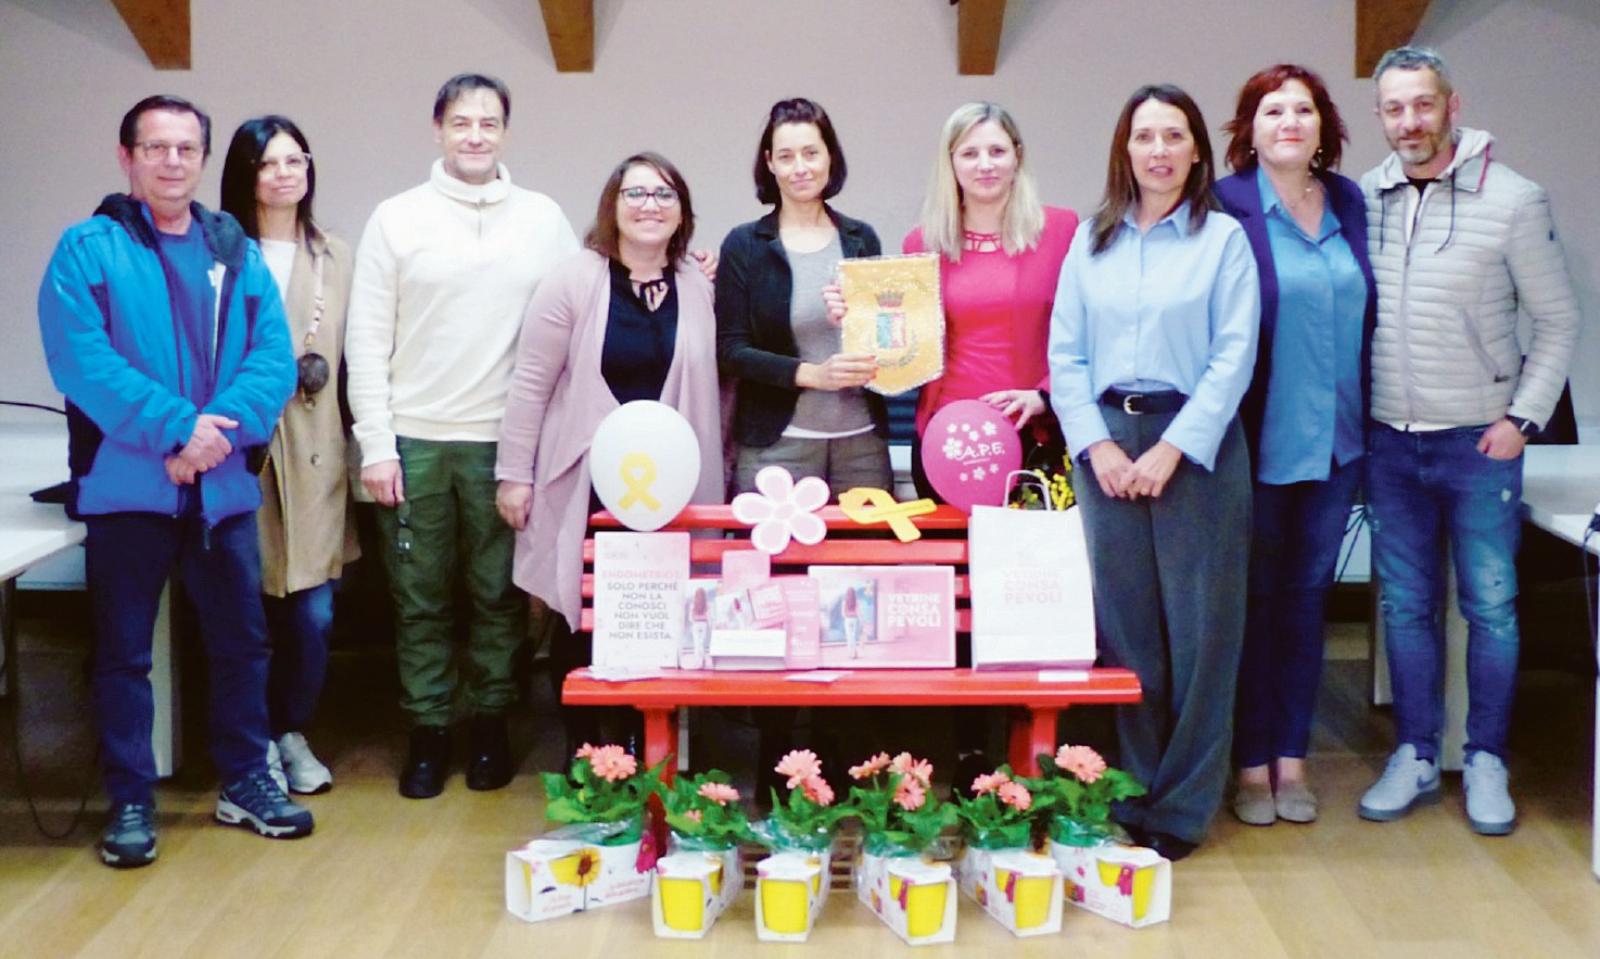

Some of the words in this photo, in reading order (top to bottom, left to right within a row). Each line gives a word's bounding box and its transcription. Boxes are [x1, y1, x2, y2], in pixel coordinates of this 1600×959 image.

[956, 442, 1005, 460] A.P.E.
[607, 582, 635, 591] SOLO
[1004, 579, 1060, 591] CONSA
[622, 592, 647, 600] NON
[650, 592, 662, 600] LA
[1004, 592, 1062, 604] PEVOLI
[618, 601, 666, 610] CONOSCI
[887, 603, 940, 615] CONSA
[614, 611, 639, 620] NON
[642, 611, 671, 620] VUOL
[618, 621, 640, 630] DIRE
[644, 621, 664, 630] CHE
[609, 631, 633, 640] NON
